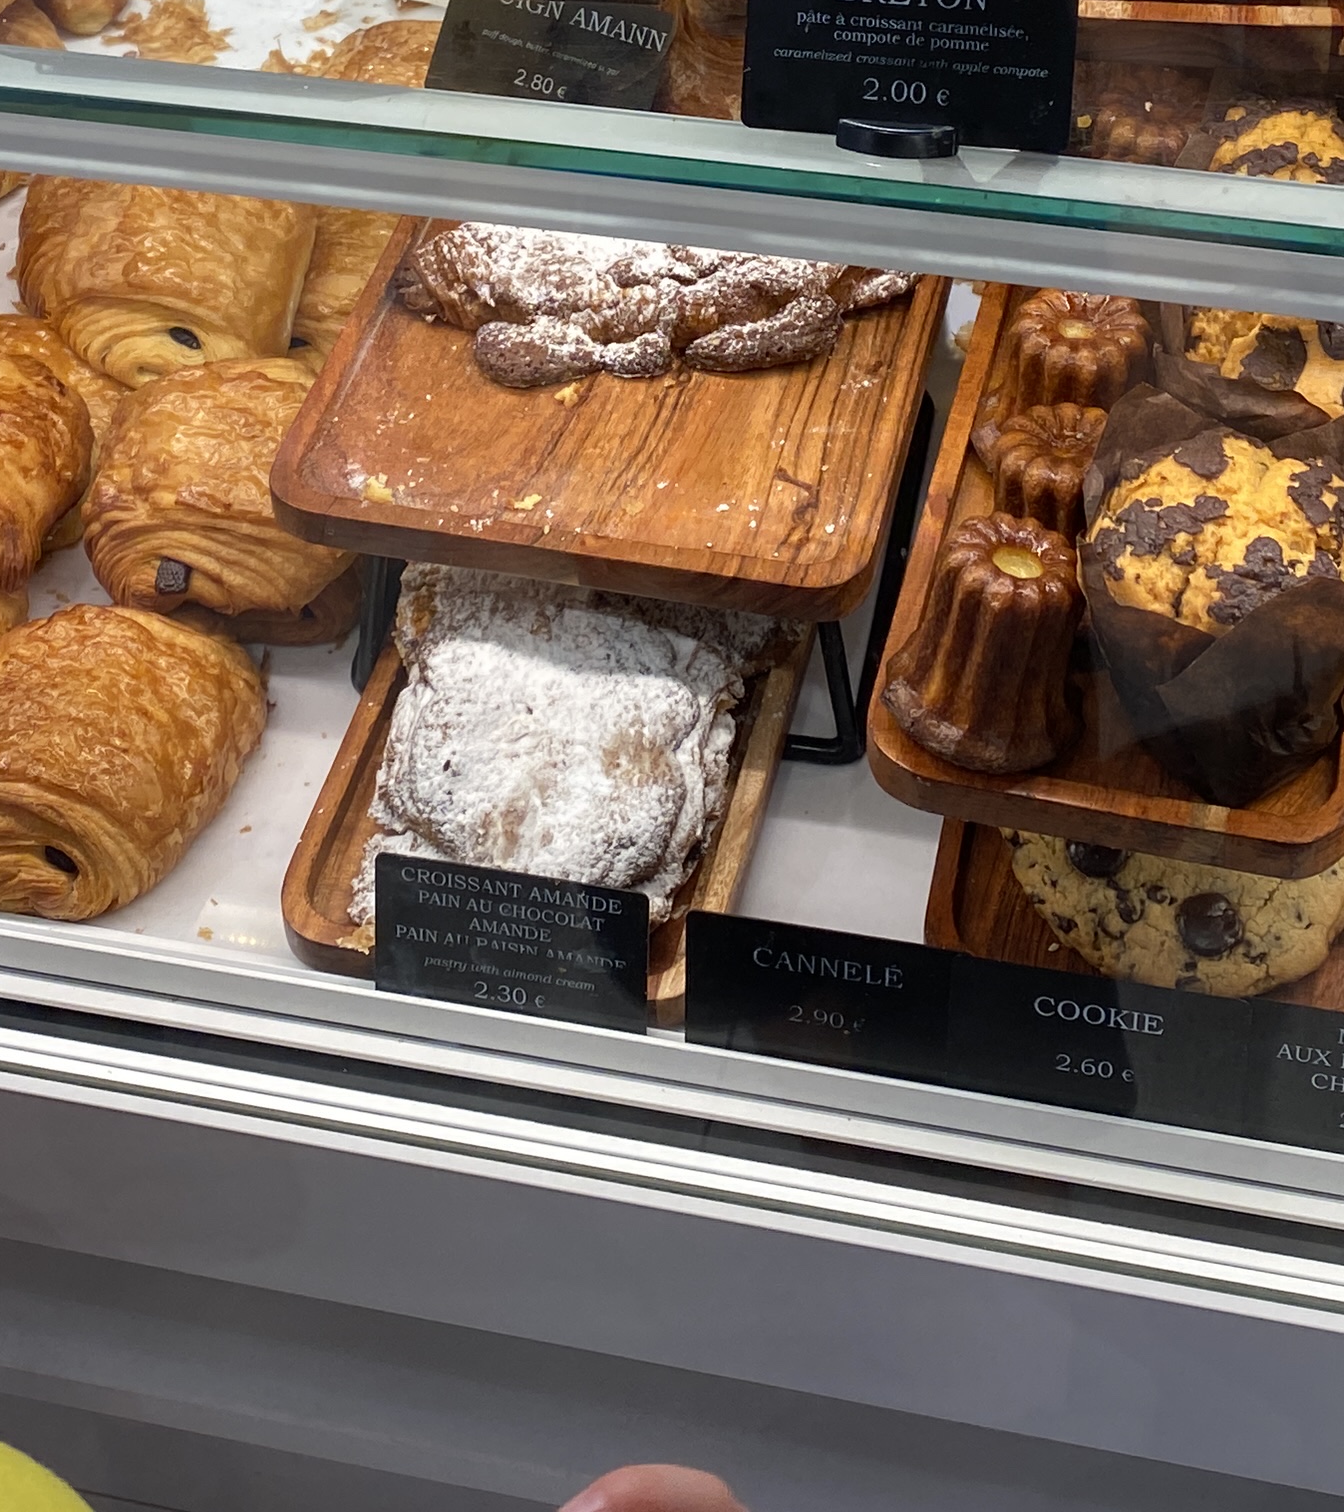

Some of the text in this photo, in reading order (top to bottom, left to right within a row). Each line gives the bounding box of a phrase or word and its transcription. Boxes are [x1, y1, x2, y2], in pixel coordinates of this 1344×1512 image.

[569, 7, 668, 53] AMANN
[797, 11, 831, 26] pâte
[836, 13, 846, 26] à
[850, 15, 922, 30] croissant
[834, 29, 990, 52] compote de pomme
[514, 69, 554, 95] 2.80
[863, 78, 950, 106] 2.00 €
[401, 867, 623, 915] CROISSANT AMANDE
[419, 890, 605, 932] PAIN AU CHOCOLAT
[396, 925, 445, 943] PAIN
[469, 918, 552, 943] AMANDE
[424, 955, 595, 991] pastry with almond cream
[753, 947, 903, 988] CANNELÉ
[474, 981, 546, 1008] 2.30 €
[789, 1005, 844, 1028] 2.90
[1033, 996, 1165, 1035] COOKIE
[1055, 1054, 1135, 1082] 2.60 €
[1276, 1044, 1333, 1066] AUX
